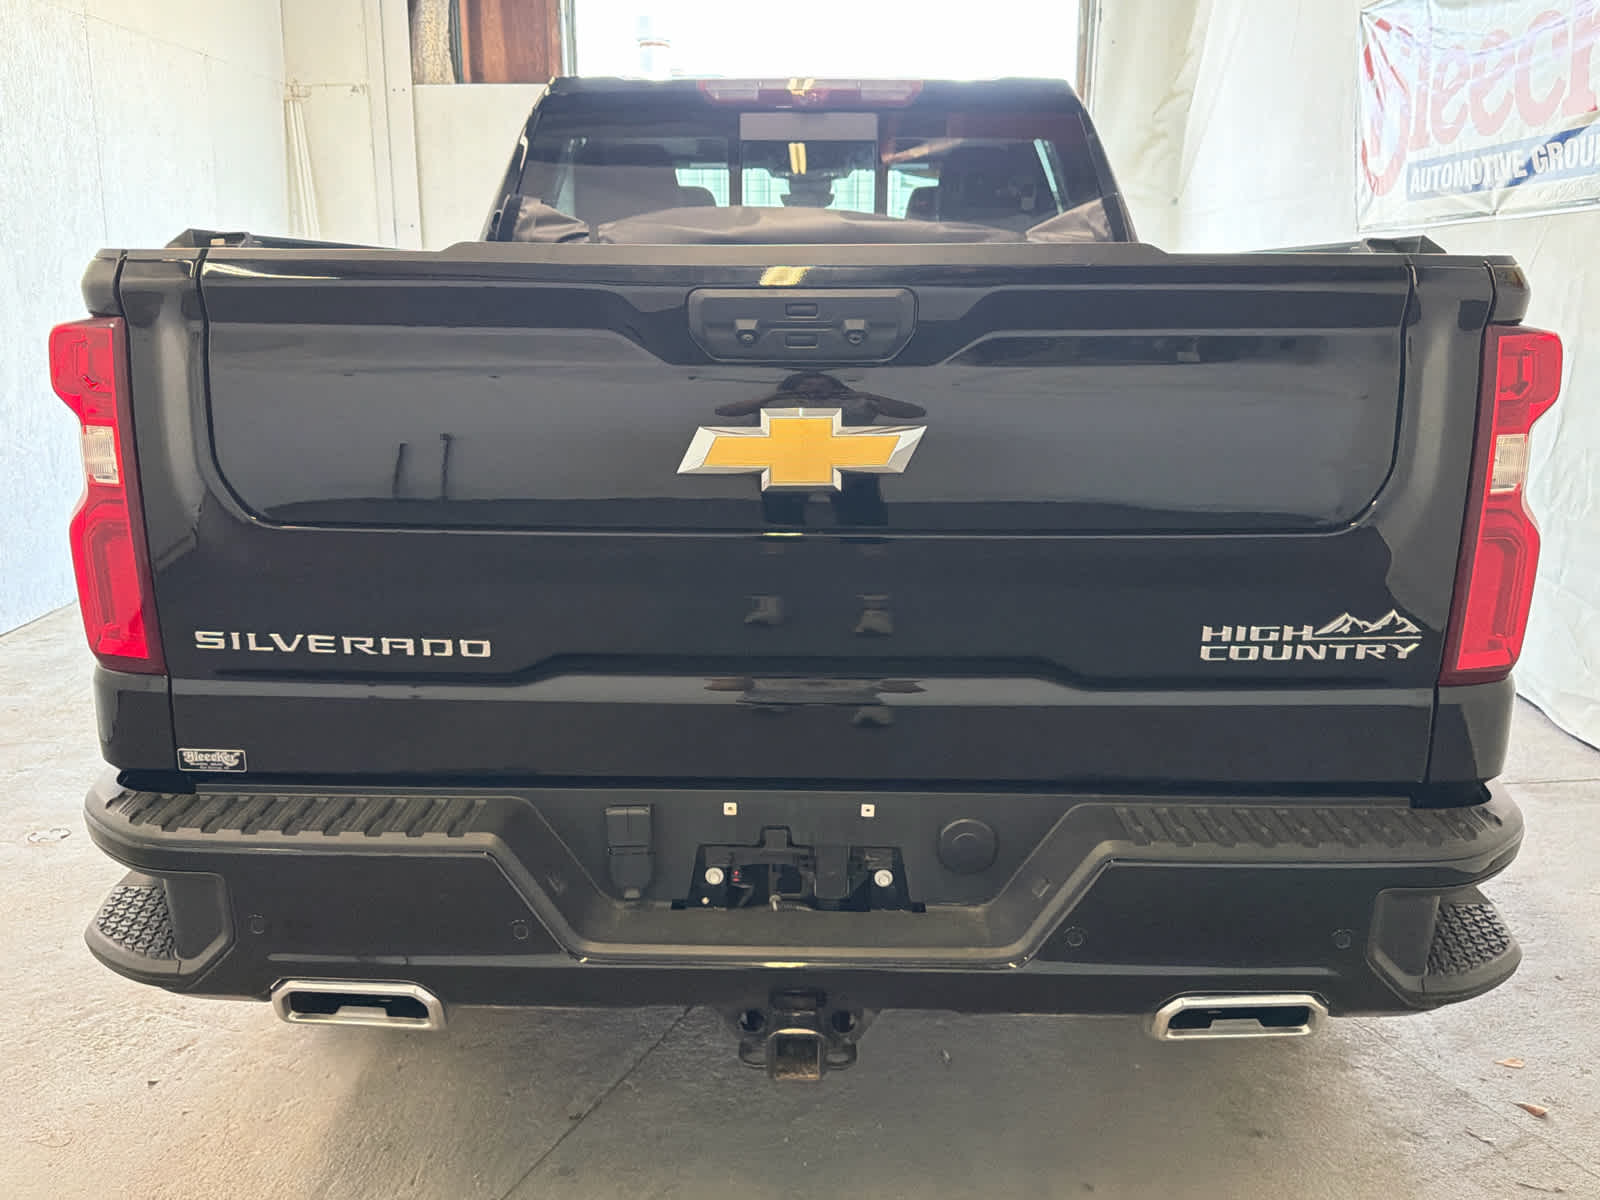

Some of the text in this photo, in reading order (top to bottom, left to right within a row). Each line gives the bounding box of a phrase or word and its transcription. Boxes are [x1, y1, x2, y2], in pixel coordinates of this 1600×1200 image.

[1410, 150, 1527, 194] AUTOMOTIVE
[1532, 133, 1600, 173] GROU
[194, 631, 491, 657] SILVERADO
[1202, 625, 1314, 642] HIGH
[1200, 643, 1420, 661] COUNTRY
